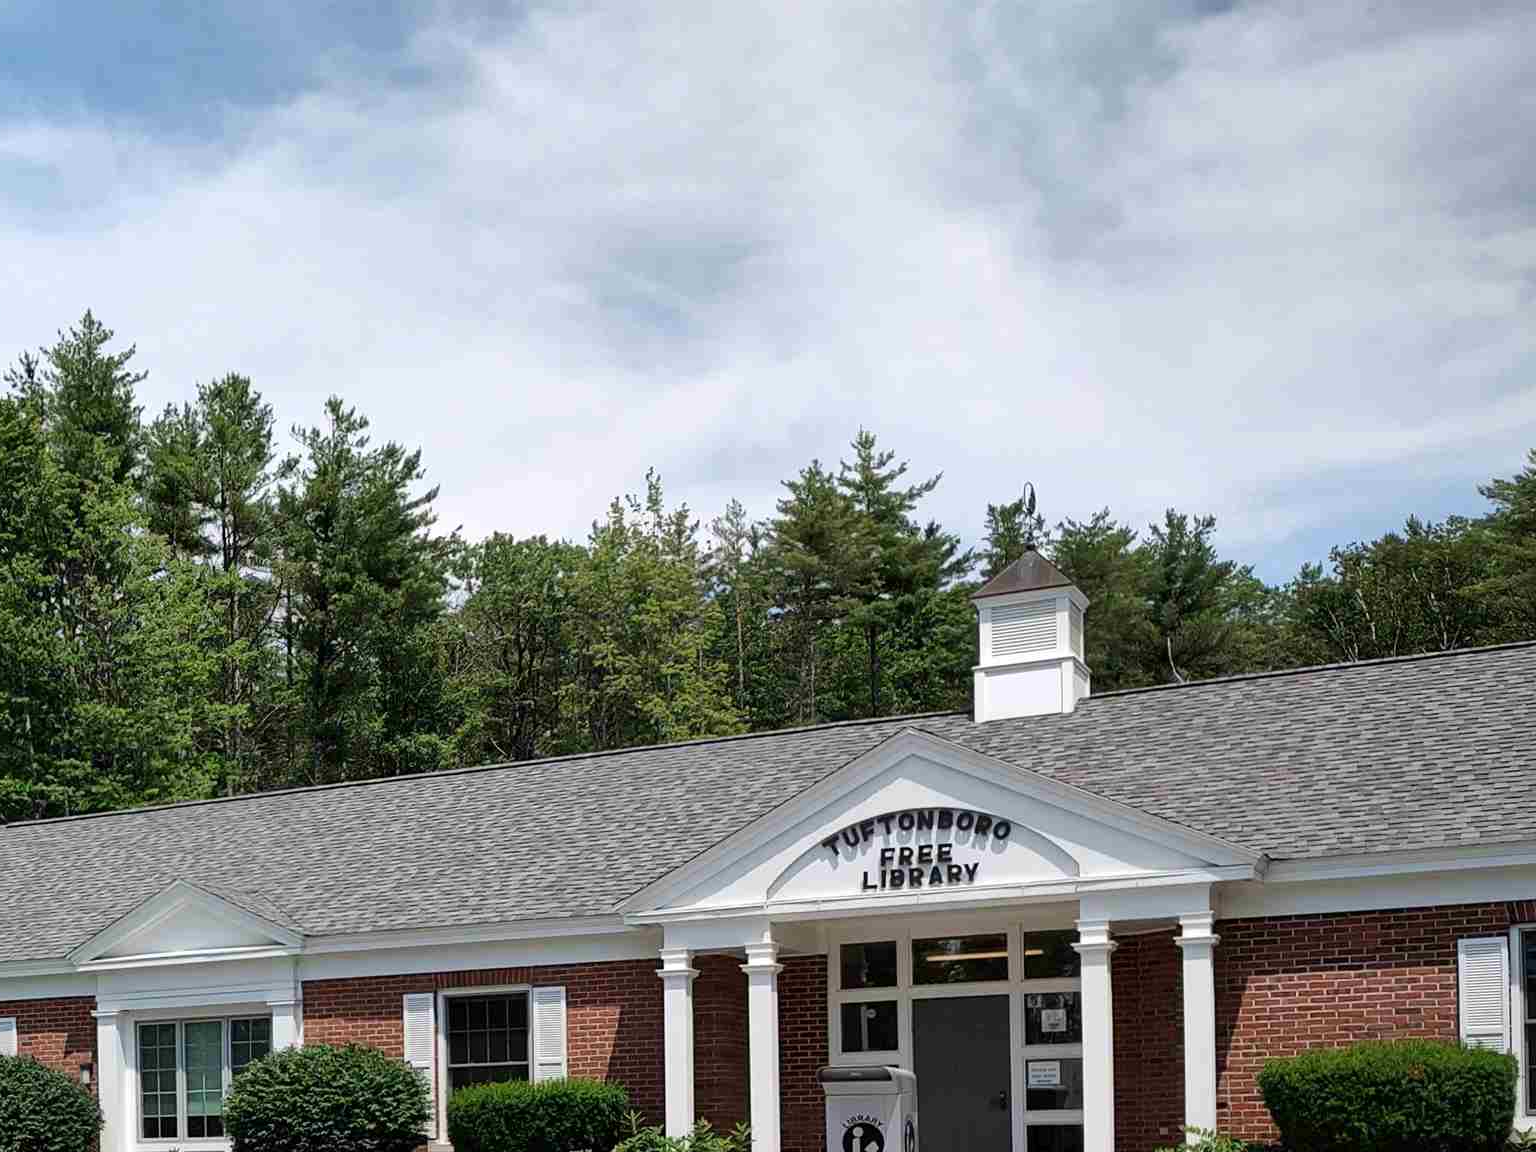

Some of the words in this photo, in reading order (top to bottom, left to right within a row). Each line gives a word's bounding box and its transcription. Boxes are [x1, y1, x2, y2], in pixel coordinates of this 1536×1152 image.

[822, 810, 1012, 857] TUFTONBORO
[880, 843, 953, 867] FREE
[862, 862, 980, 890] LIBRARY
